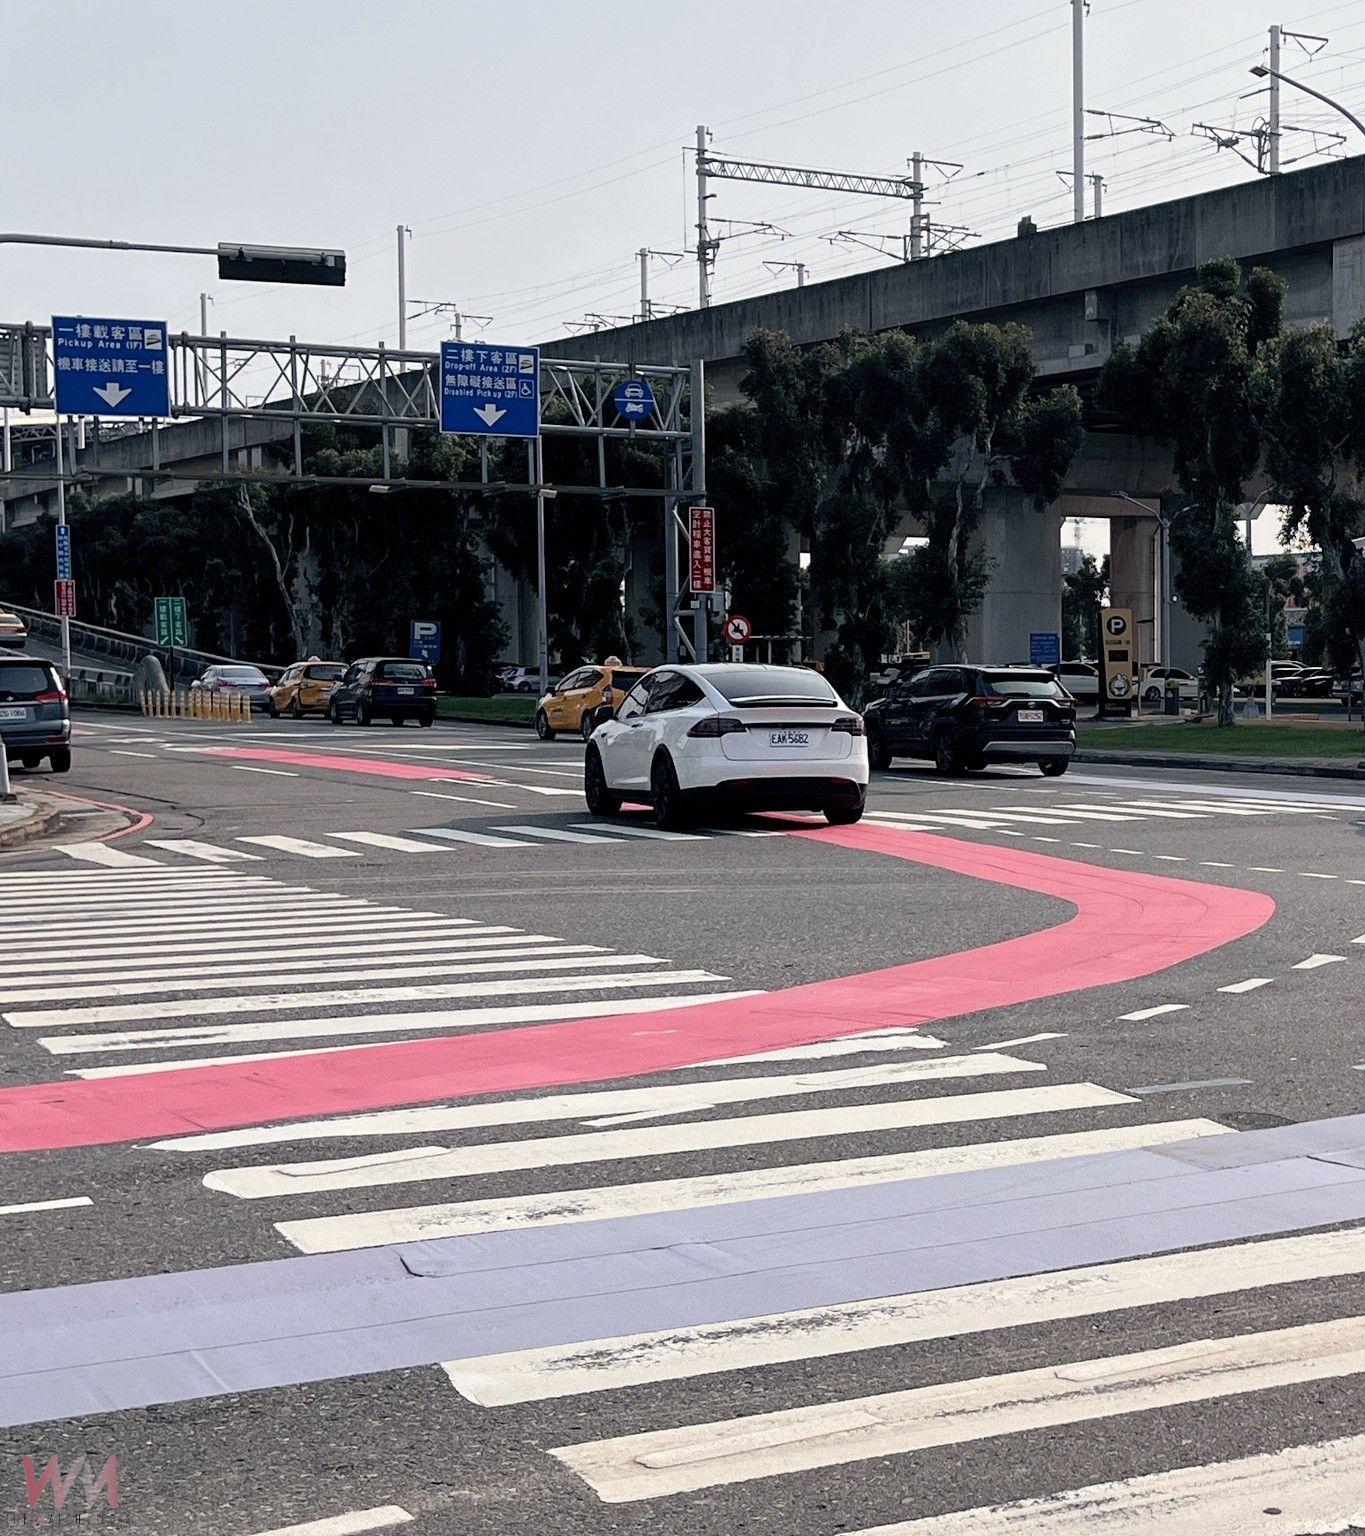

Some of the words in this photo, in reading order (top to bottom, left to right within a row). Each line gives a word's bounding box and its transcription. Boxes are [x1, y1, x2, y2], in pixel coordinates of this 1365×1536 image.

[58, 323, 143, 340] 一樓載客區
[58, 338, 93, 349] Pickup
[98, 340, 121, 349] Area
[126, 341, 143, 350] (1F)
[446, 348, 517, 365] 二樓下客區
[57, 357, 165, 375] 機車接送請至一樓
[445, 361, 476, 371] Drop-off
[480, 364, 498, 372] Area
[502, 365, 517, 374] (2F)
[445, 374, 517, 390] 無障礙接送區
[444, 387, 474, 396] Disabled
[414, 622, 437, 639] P
[1111, 618, 1124, 633] P
